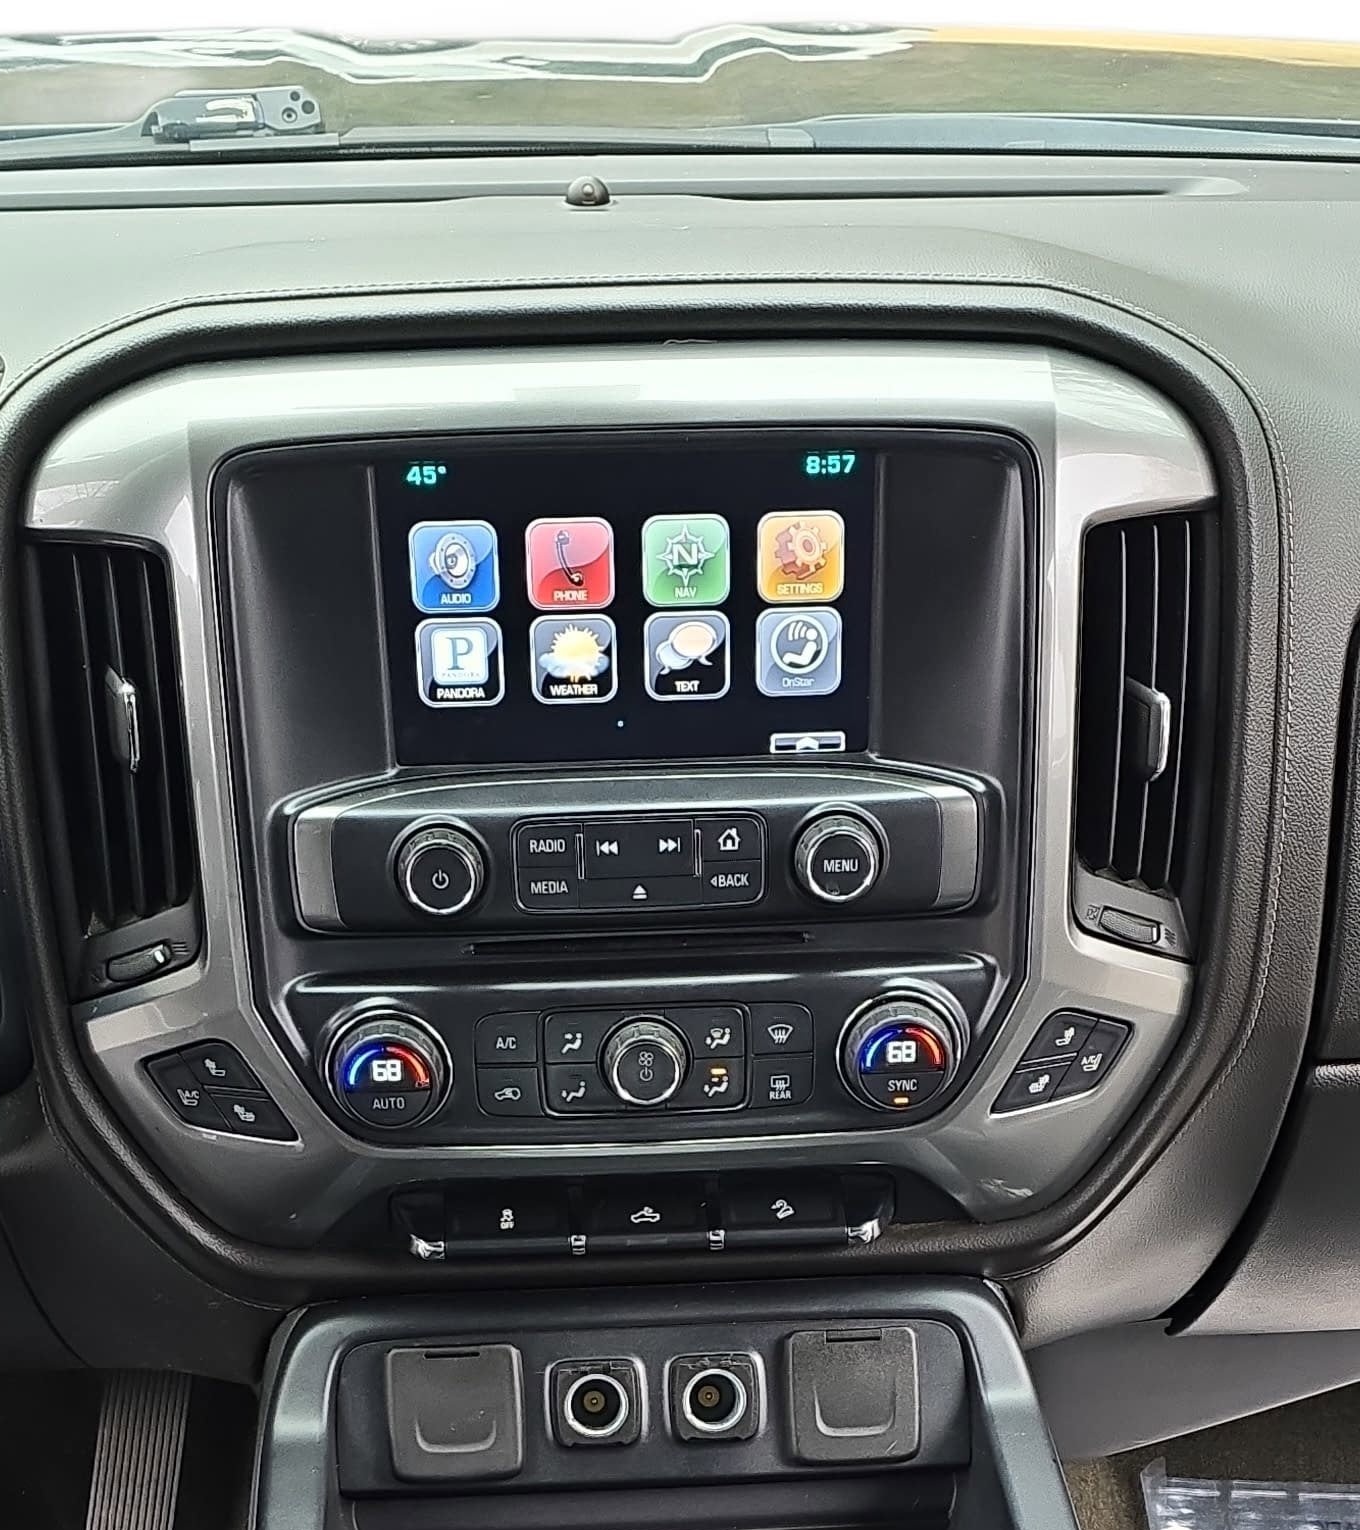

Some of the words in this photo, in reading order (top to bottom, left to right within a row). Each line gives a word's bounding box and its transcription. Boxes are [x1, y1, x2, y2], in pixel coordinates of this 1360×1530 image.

[806, 454, 856, 475] 8:57
[405, 465, 447, 486] 45°
[553, 589, 589, 602] PHONE
[674, 586, 698, 599] NAV
[775, 582, 824, 596] SETTINGS
[440, 593, 472, 605] AUDIO
[550, 682, 598, 696] WEATHER
[675, 680, 700, 693] TEXT
[782, 675, 815, 688] OnStar
[436, 687, 486, 700] PANDORA
[528, 838, 567, 855] RADIO
[823, 857, 859, 875] MENU
[530, 878, 569, 897] MEDIA
[717, 871, 750, 890] BACK
[495, 1034, 518, 1051] A/C
[886, 1039, 917, 1064] 68
[371, 1059, 402, 1083] 68
[887, 1078, 918, 1094] SYNC
[372, 1095, 406, 1112] AUTO
[769, 1090, 792, 1101] REAR
